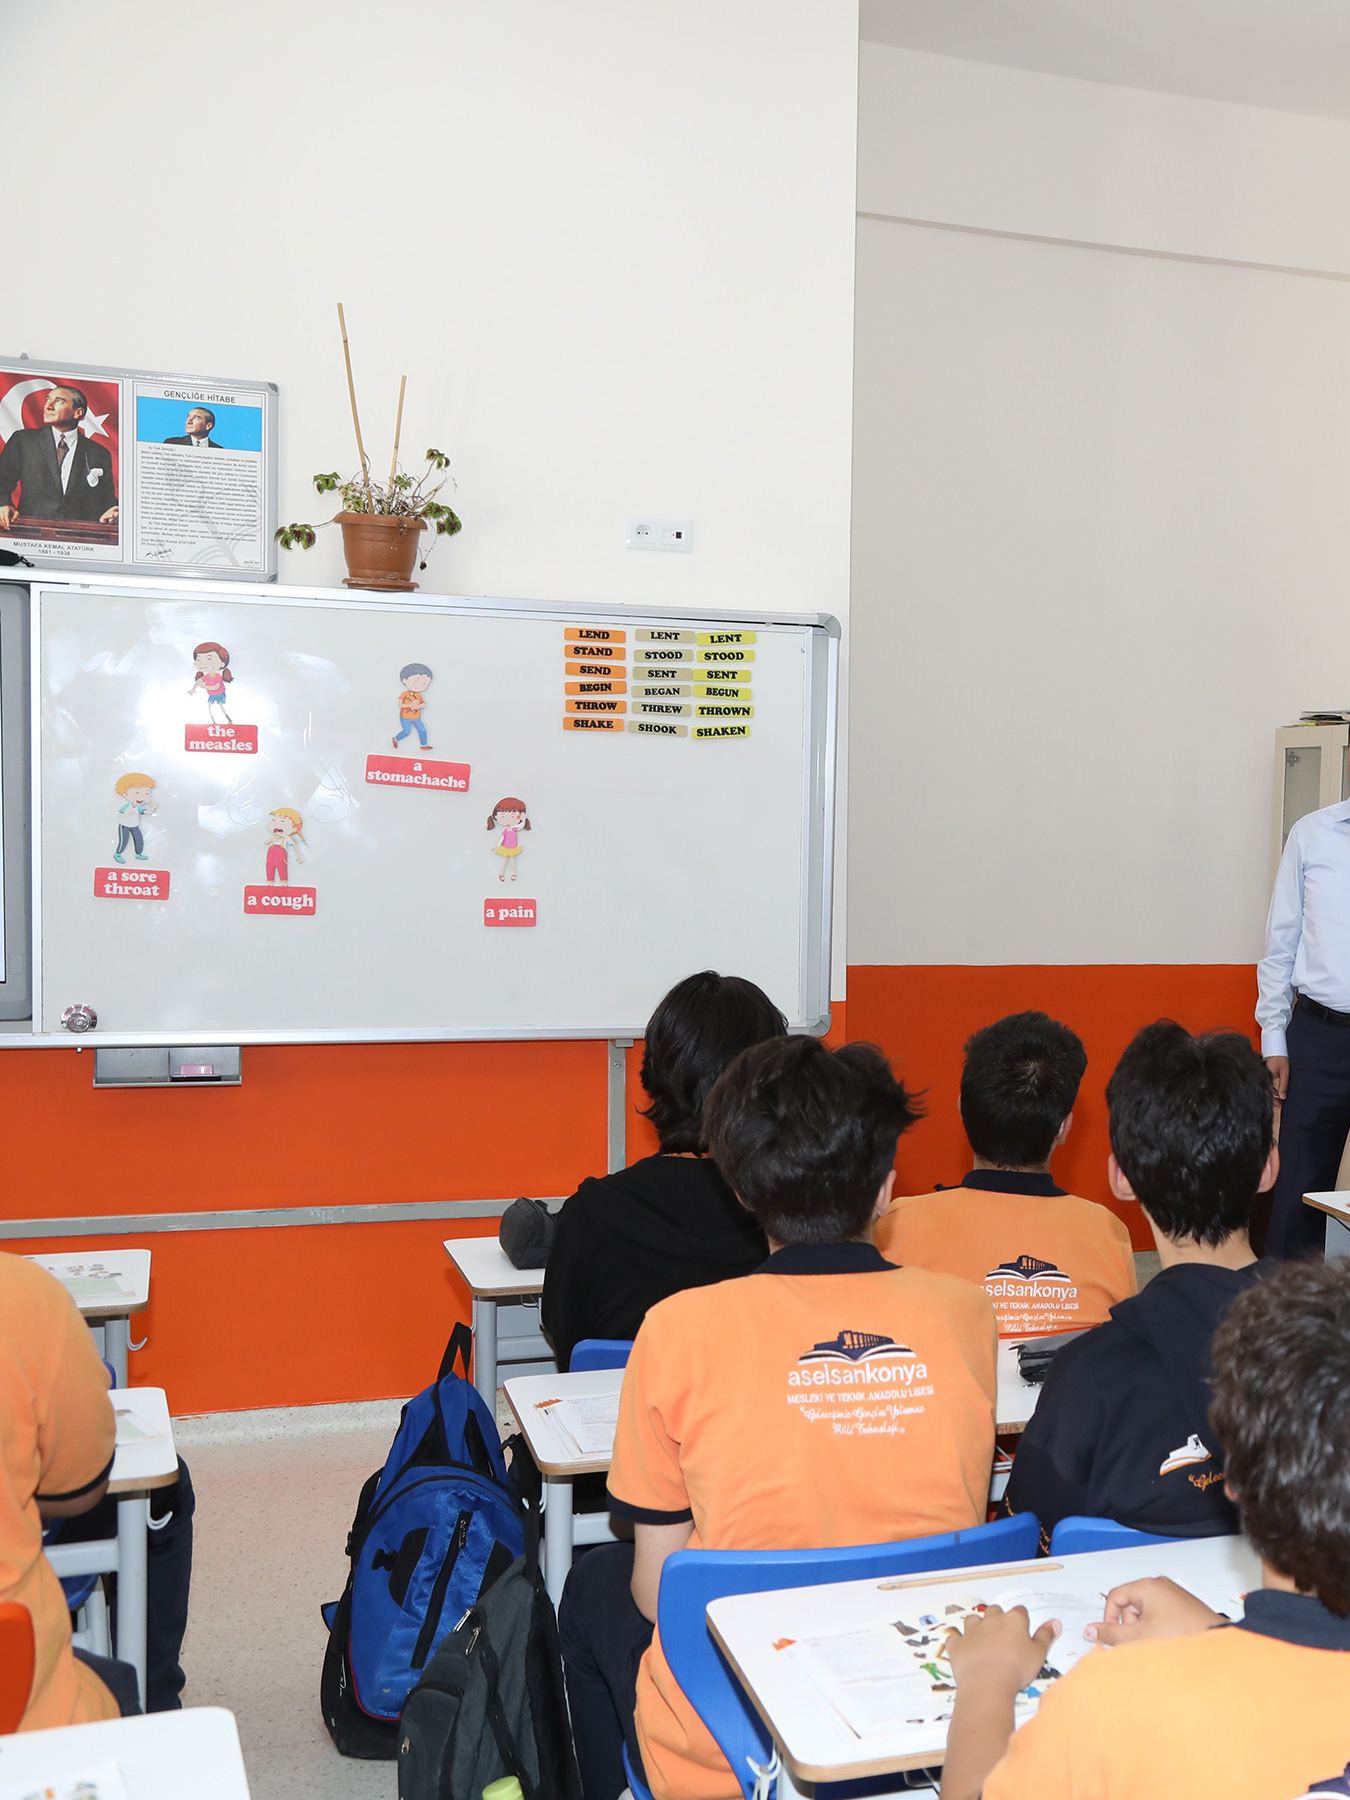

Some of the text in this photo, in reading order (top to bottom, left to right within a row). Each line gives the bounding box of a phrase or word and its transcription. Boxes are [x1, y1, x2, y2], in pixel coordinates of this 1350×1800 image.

[164, 390, 236, 404] GENÇLİĞE HİTABE
[13, 541, 42, 549] MUSTAFA
[579, 630, 610, 640] LEND
[650, 632, 680, 641] LENT
[710, 634, 742, 644] LENT
[573, 647, 613, 656] STAND
[644, 651, 683, 660] STOOD
[704, 652, 744, 661] STOOD
[579, 666, 611, 675] SEND
[647, 670, 677, 678] SENT
[706, 671, 738, 680] SENT
[579, 683, 612, 692] BEGIN
[644, 688, 680, 696] BEGAN
[706, 687, 739, 697] BEGUN
[575, 701, 617, 711] THROW
[641, 704, 682, 714] THREW
[699, 706, 750, 716] THROWN
[573, 719, 613, 729] SHAKE
[638, 724, 677, 734] SHOOK
[207, 725, 235, 737] the
[696, 727, 746, 737] SHAKEN
[189, 738, 253, 751] measles
[413, 762, 422, 771] a
[367, 770, 466, 789] stomachache
[107, 871, 157, 882] a sore
[104, 883, 160, 896] throat
[247, 894, 313, 910] a cough
[486, 906, 534, 920] a pain
[980, 1280, 1077, 1301] selsankonya
[788, 1363, 928, 1386] aselsankonya
[787, 1385, 934, 1404] MESLEKİ VE TEKNİK ANADOLU LİSESİ
